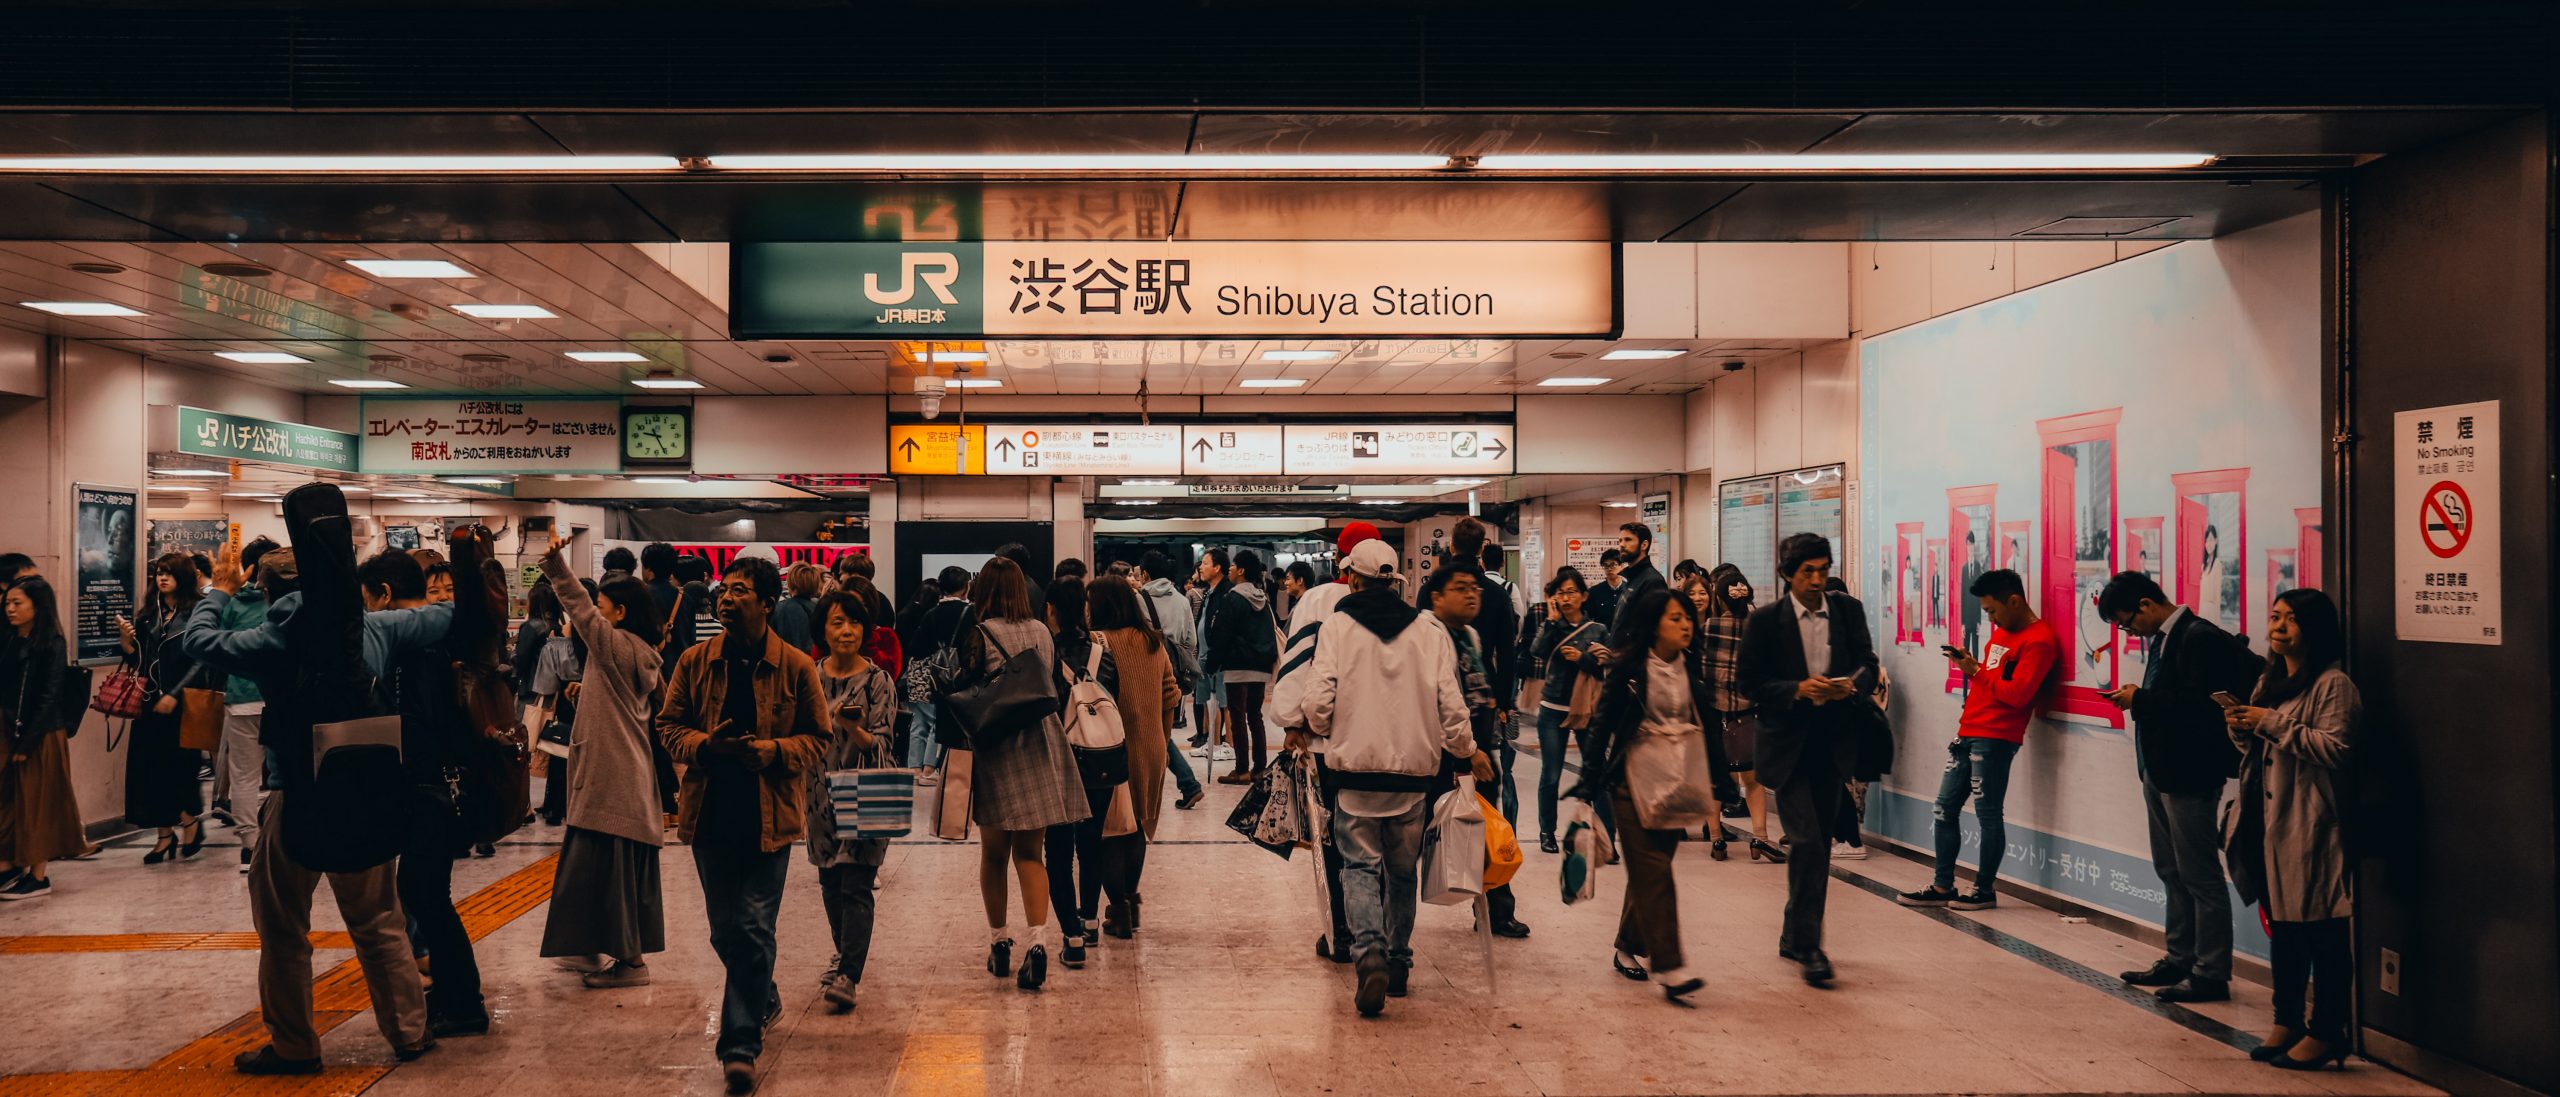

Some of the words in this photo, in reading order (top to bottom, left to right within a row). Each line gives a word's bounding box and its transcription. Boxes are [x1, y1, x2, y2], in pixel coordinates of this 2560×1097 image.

[863, 252, 959, 305] JR
[1009, 258, 1192, 315] 渋谷駅
[1217, 285, 1359, 323] Shibuya
[1372, 285, 1493, 316] Station
[876, 308, 946, 324] JR東日本
[459, 401, 524, 415] ハチ公改札には
[198, 417, 219, 441] JR
[1042, 431, 1082, 442] 副都心線
[1324, 431, 1348, 442] JR線
[2417, 421, 2433, 444] 禁
[2457, 416, 2474, 440] 煙
[223, 424, 293, 458] ハチ公改札
[1385, 431, 1448, 443] みどりの窓口
[2418, 448, 2431, 459] No
[2433, 444, 2474, 458] Smoking
[2425, 573, 2468, 587] 終日禁煙
[2415, 591, 2479, 602] お客さまのご協力を
[2415, 604, 2476, 616] お願いいたします。
[2006, 842, 2101, 886] エントリー受付中
